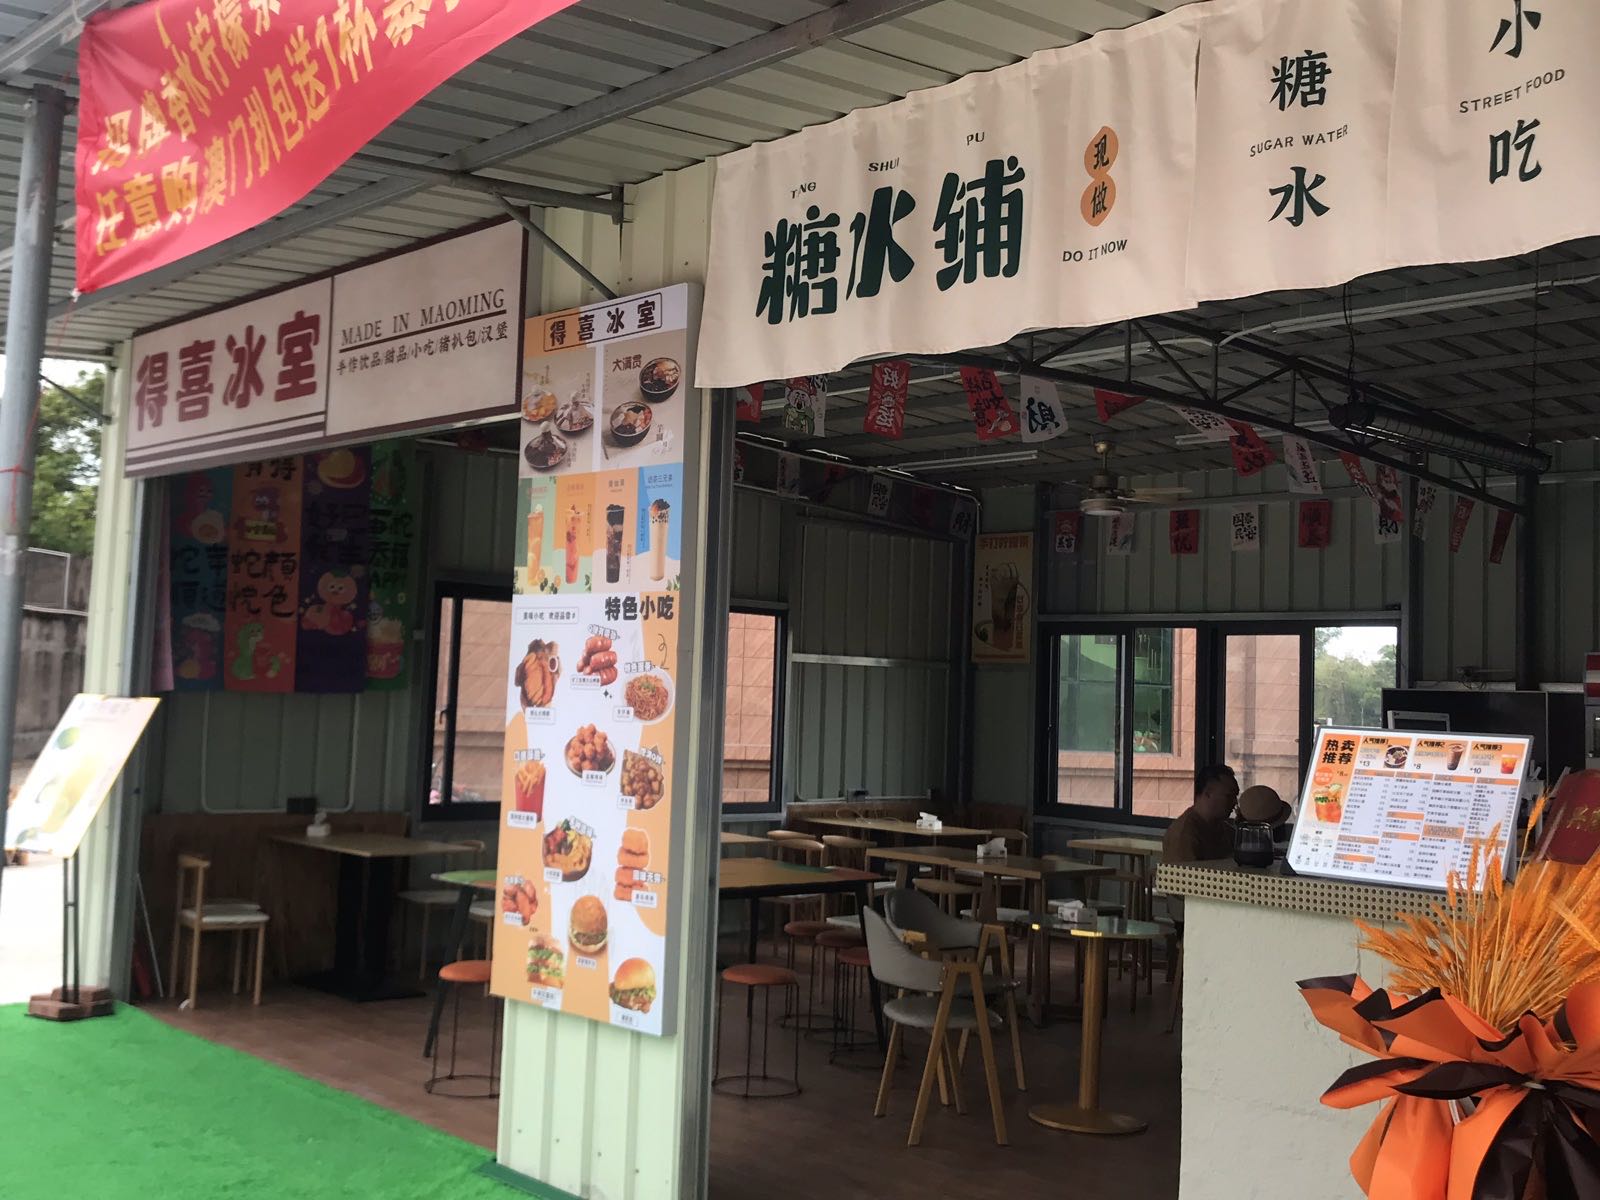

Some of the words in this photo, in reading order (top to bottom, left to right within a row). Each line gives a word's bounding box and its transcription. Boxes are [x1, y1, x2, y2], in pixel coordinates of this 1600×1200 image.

[1488, 0, 1542, 59] 小
[1458, 85, 1522, 114] STREET
[1525, 68, 1566, 93] FOOD
[868, 157, 900, 173] SHUI
[966, 131, 986, 146] PU
[1249, 135, 1294, 158] SUGAR
[1302, 124, 1349, 147] WATER
[1090, 133, 1111, 219] 现做
[756, 155, 1026, 325] 糖水铺
[1062, 248, 1084, 264] DO
[1088, 246, 1100, 261] IT
[1100, 239, 1128, 257] NOW
[341, 320, 382, 346] MADE
[392, 313, 409, 333] IN
[421, 288, 505, 325] MAOMING
[549, 300, 656, 347] 得喜冰室
[135, 309, 321, 432] 得喜冰室
[604, 594, 675, 622] 特色小吃
[1322, 752, 1353, 765] 推荐
[1325, 739, 1356, 752] 热卖
